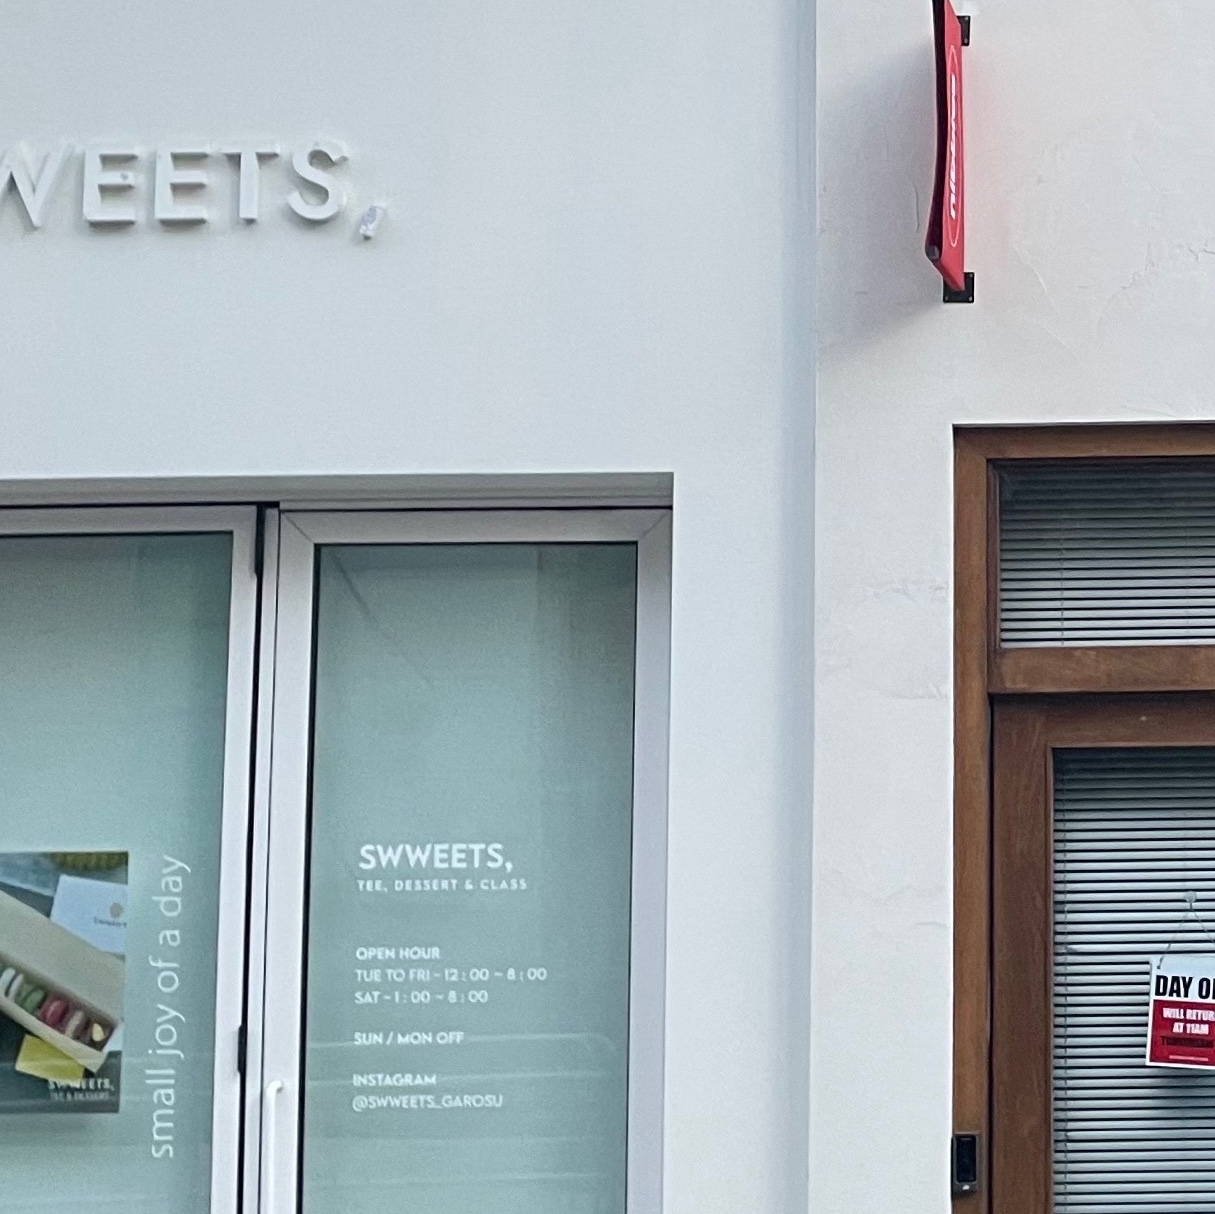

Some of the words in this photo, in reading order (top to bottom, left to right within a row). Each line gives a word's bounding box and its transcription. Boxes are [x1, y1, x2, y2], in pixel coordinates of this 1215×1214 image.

[358, 842, 514, 873] SWWEETS,
[151, 854, 191, 917] day
[394, 879, 458, 891] DESSERT
[480, 878, 527, 891] CLASS
[158, 929, 181, 947] a
[355, 947, 396, 960] OPEN
[399, 946, 441, 960] HOUR
[148, 955, 180, 993] of
[355, 968, 382, 982] TUE
[386, 968, 406, 982] TO
[409, 968, 431, 981] FRI
[1155, 974, 1194, 999] DAY
[354, 991, 381, 1004] SAT
[1162, 1008, 1184, 1020] WILL
[147, 1003, 185, 1060] joy
[1172, 1022, 1184, 1034] AT
[353, 1032, 384, 1045] SUN
[397, 1032, 433, 1045] MON
[436, 1032, 465, 1044] OFF
[353, 1074, 437, 1087] INSTAGRAM
[352, 1094, 504, 1112] @SWWEETS_GAROSU
[145, 1067, 175, 1158] small
